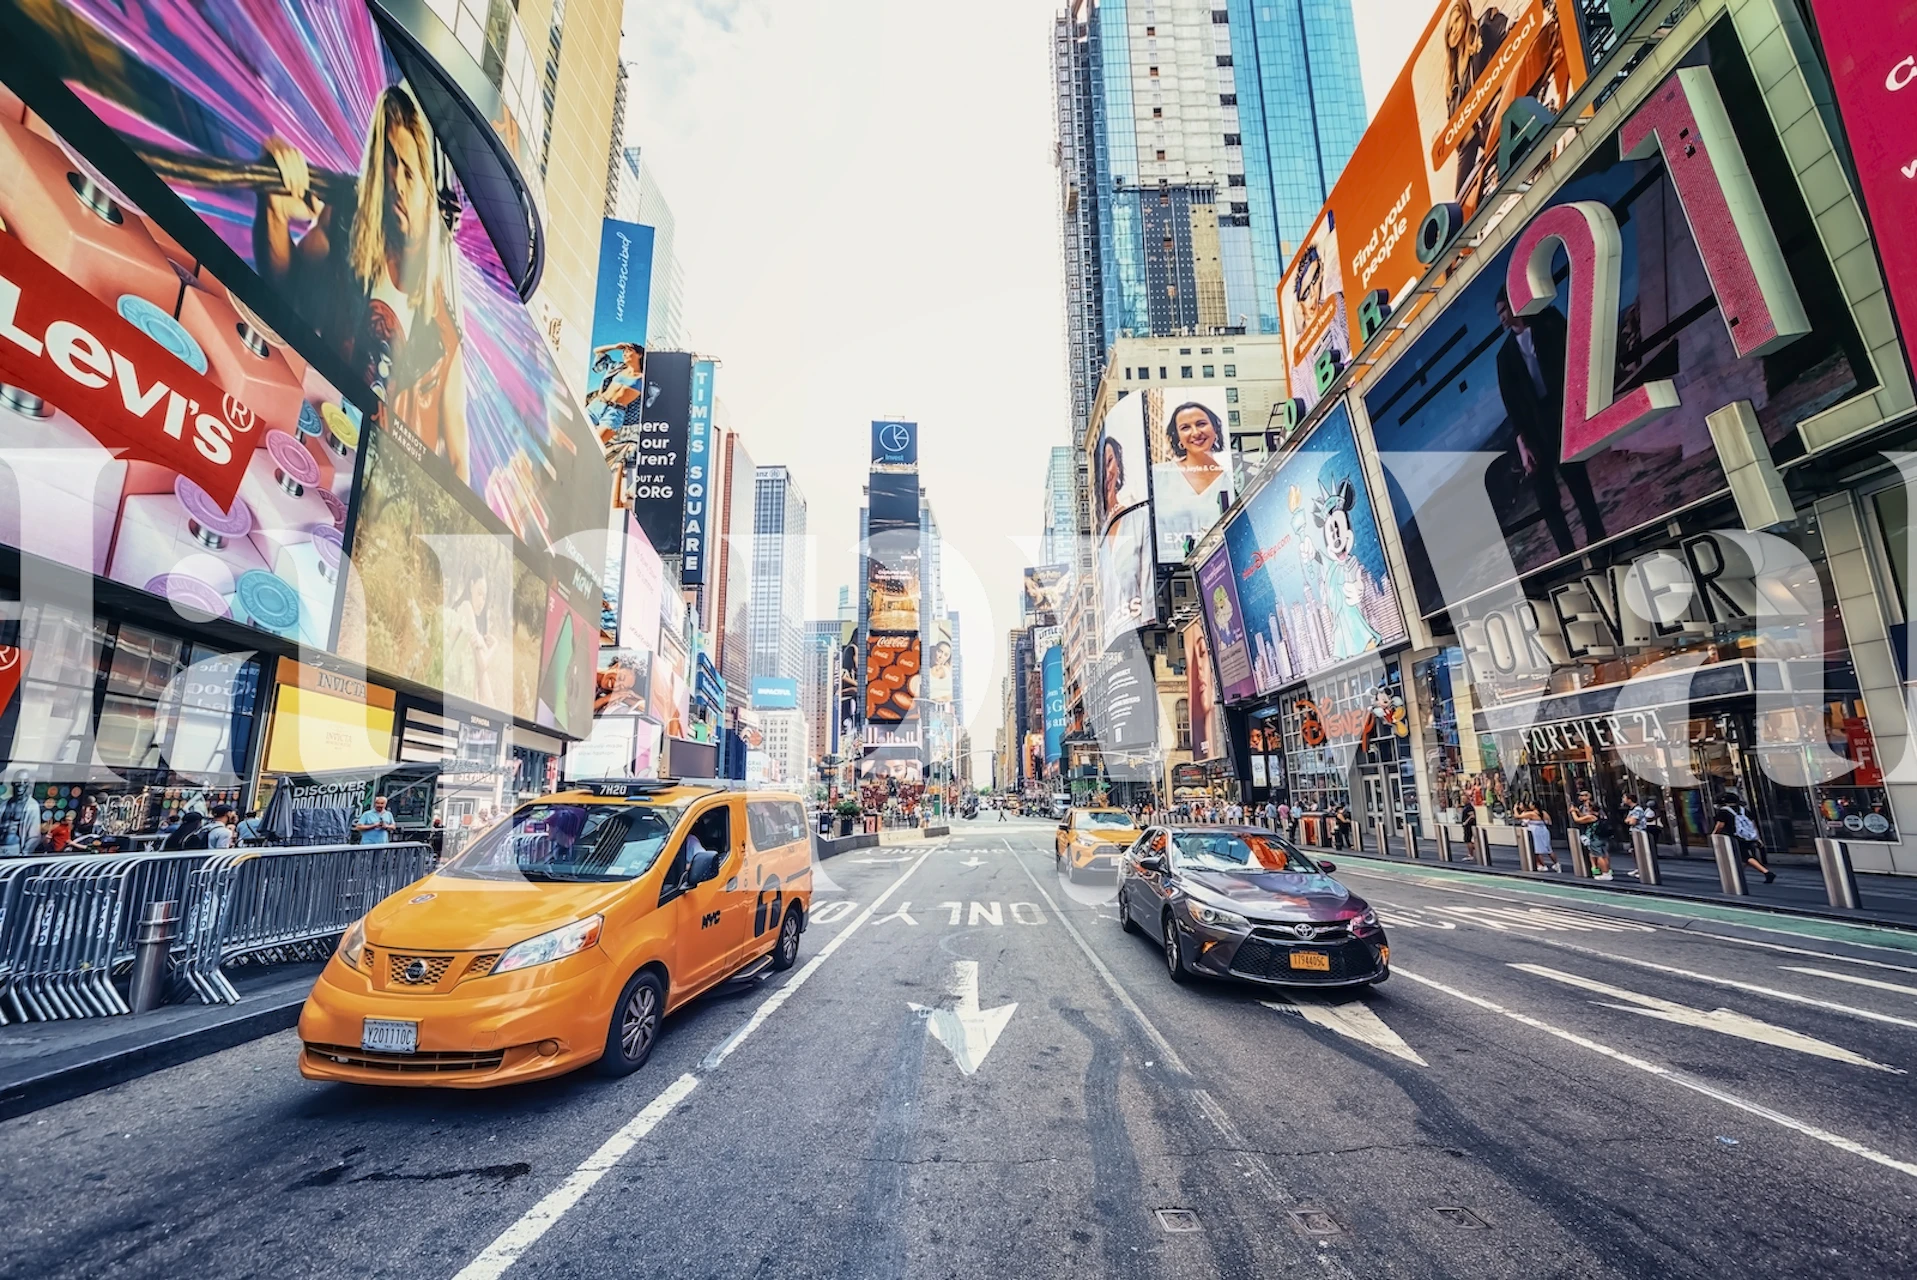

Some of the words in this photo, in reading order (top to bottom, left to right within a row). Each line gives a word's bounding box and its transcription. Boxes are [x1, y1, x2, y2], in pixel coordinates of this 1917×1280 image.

[1352, 228, 1379, 276] Find
[1379, 181, 1413, 241] your
[1361, 217, 1408, 290] people
[1506, 66, 1806, 465] 21
[0, 276, 233, 466] Levi's
[691, 372, 709, 453] TIMES
[391, 429, 422, 461] MARQUIS
[393, 418, 427, 454] MARRIOTT
[653, 475, 665, 483] AT
[684, 466, 704, 570] SQUARE
[572, 568, 593, 600] NOW
[1455, 532, 1755, 685] FOREVER
[1039, 626, 1058, 639] LITTLE
[317, 671, 366, 698] INVICTA
[470, 715, 490, 727] SEPHORA
[1294, 696, 1375, 753] Disney
[1518, 715, 1629, 754] FOREVER
[1633, 711, 1667, 743] 21
[293, 780, 366, 797] DISCOVER
[702, 910, 720, 930] NYC
[871, 900, 1048, 927] ONLY
